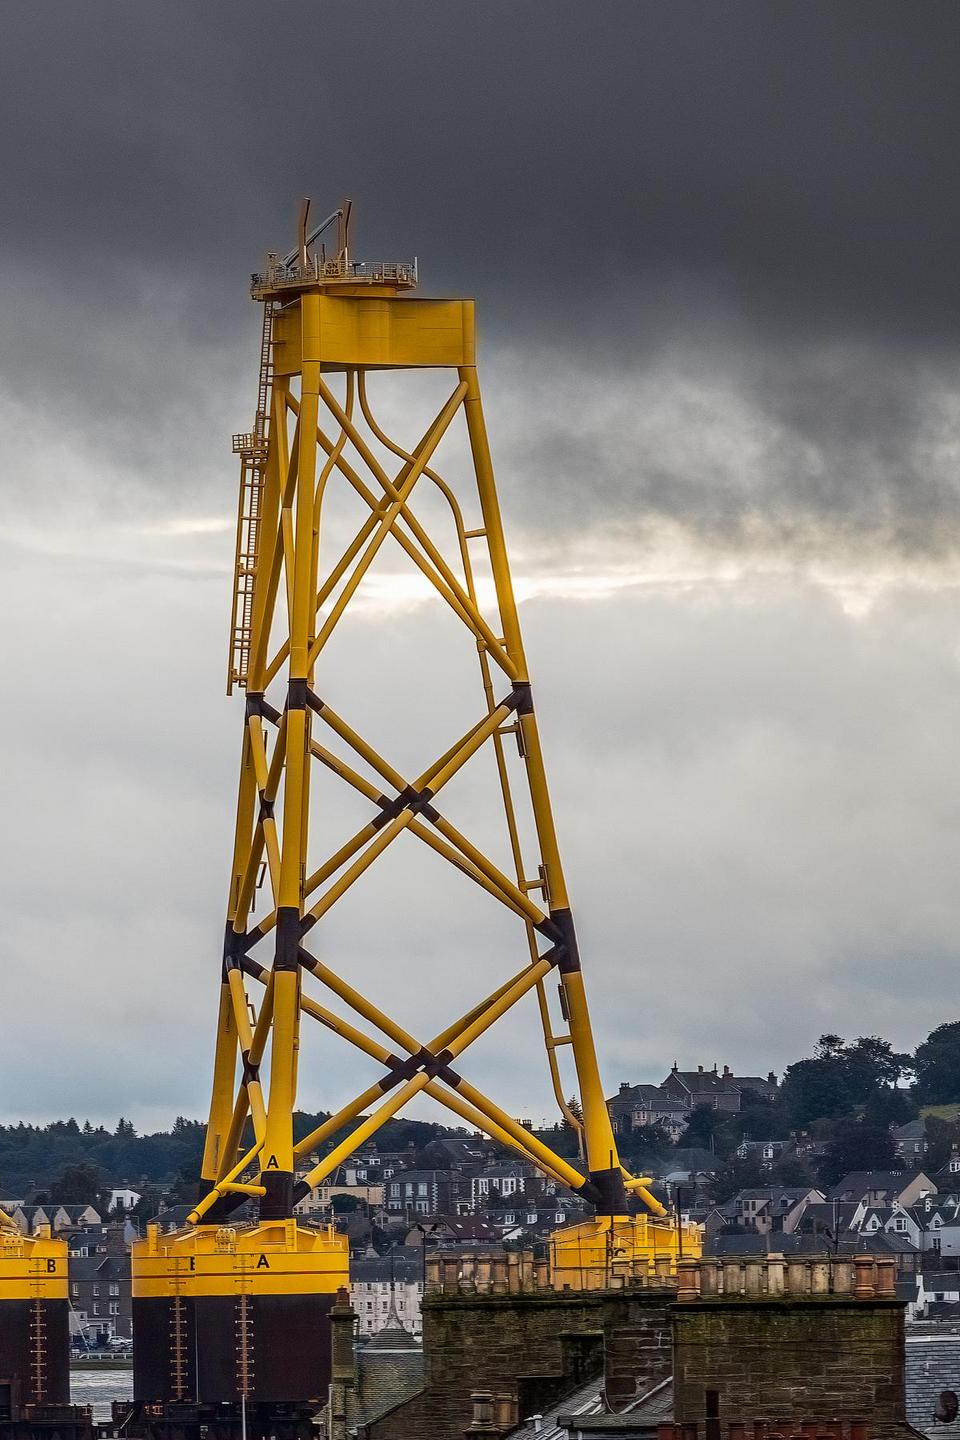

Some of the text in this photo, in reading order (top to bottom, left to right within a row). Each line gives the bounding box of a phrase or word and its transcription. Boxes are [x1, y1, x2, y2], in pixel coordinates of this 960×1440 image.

[266, 1155, 279, 1169] A
[46, 1259, 56, 1273] B
[256, 1254, 270, 1269] A
